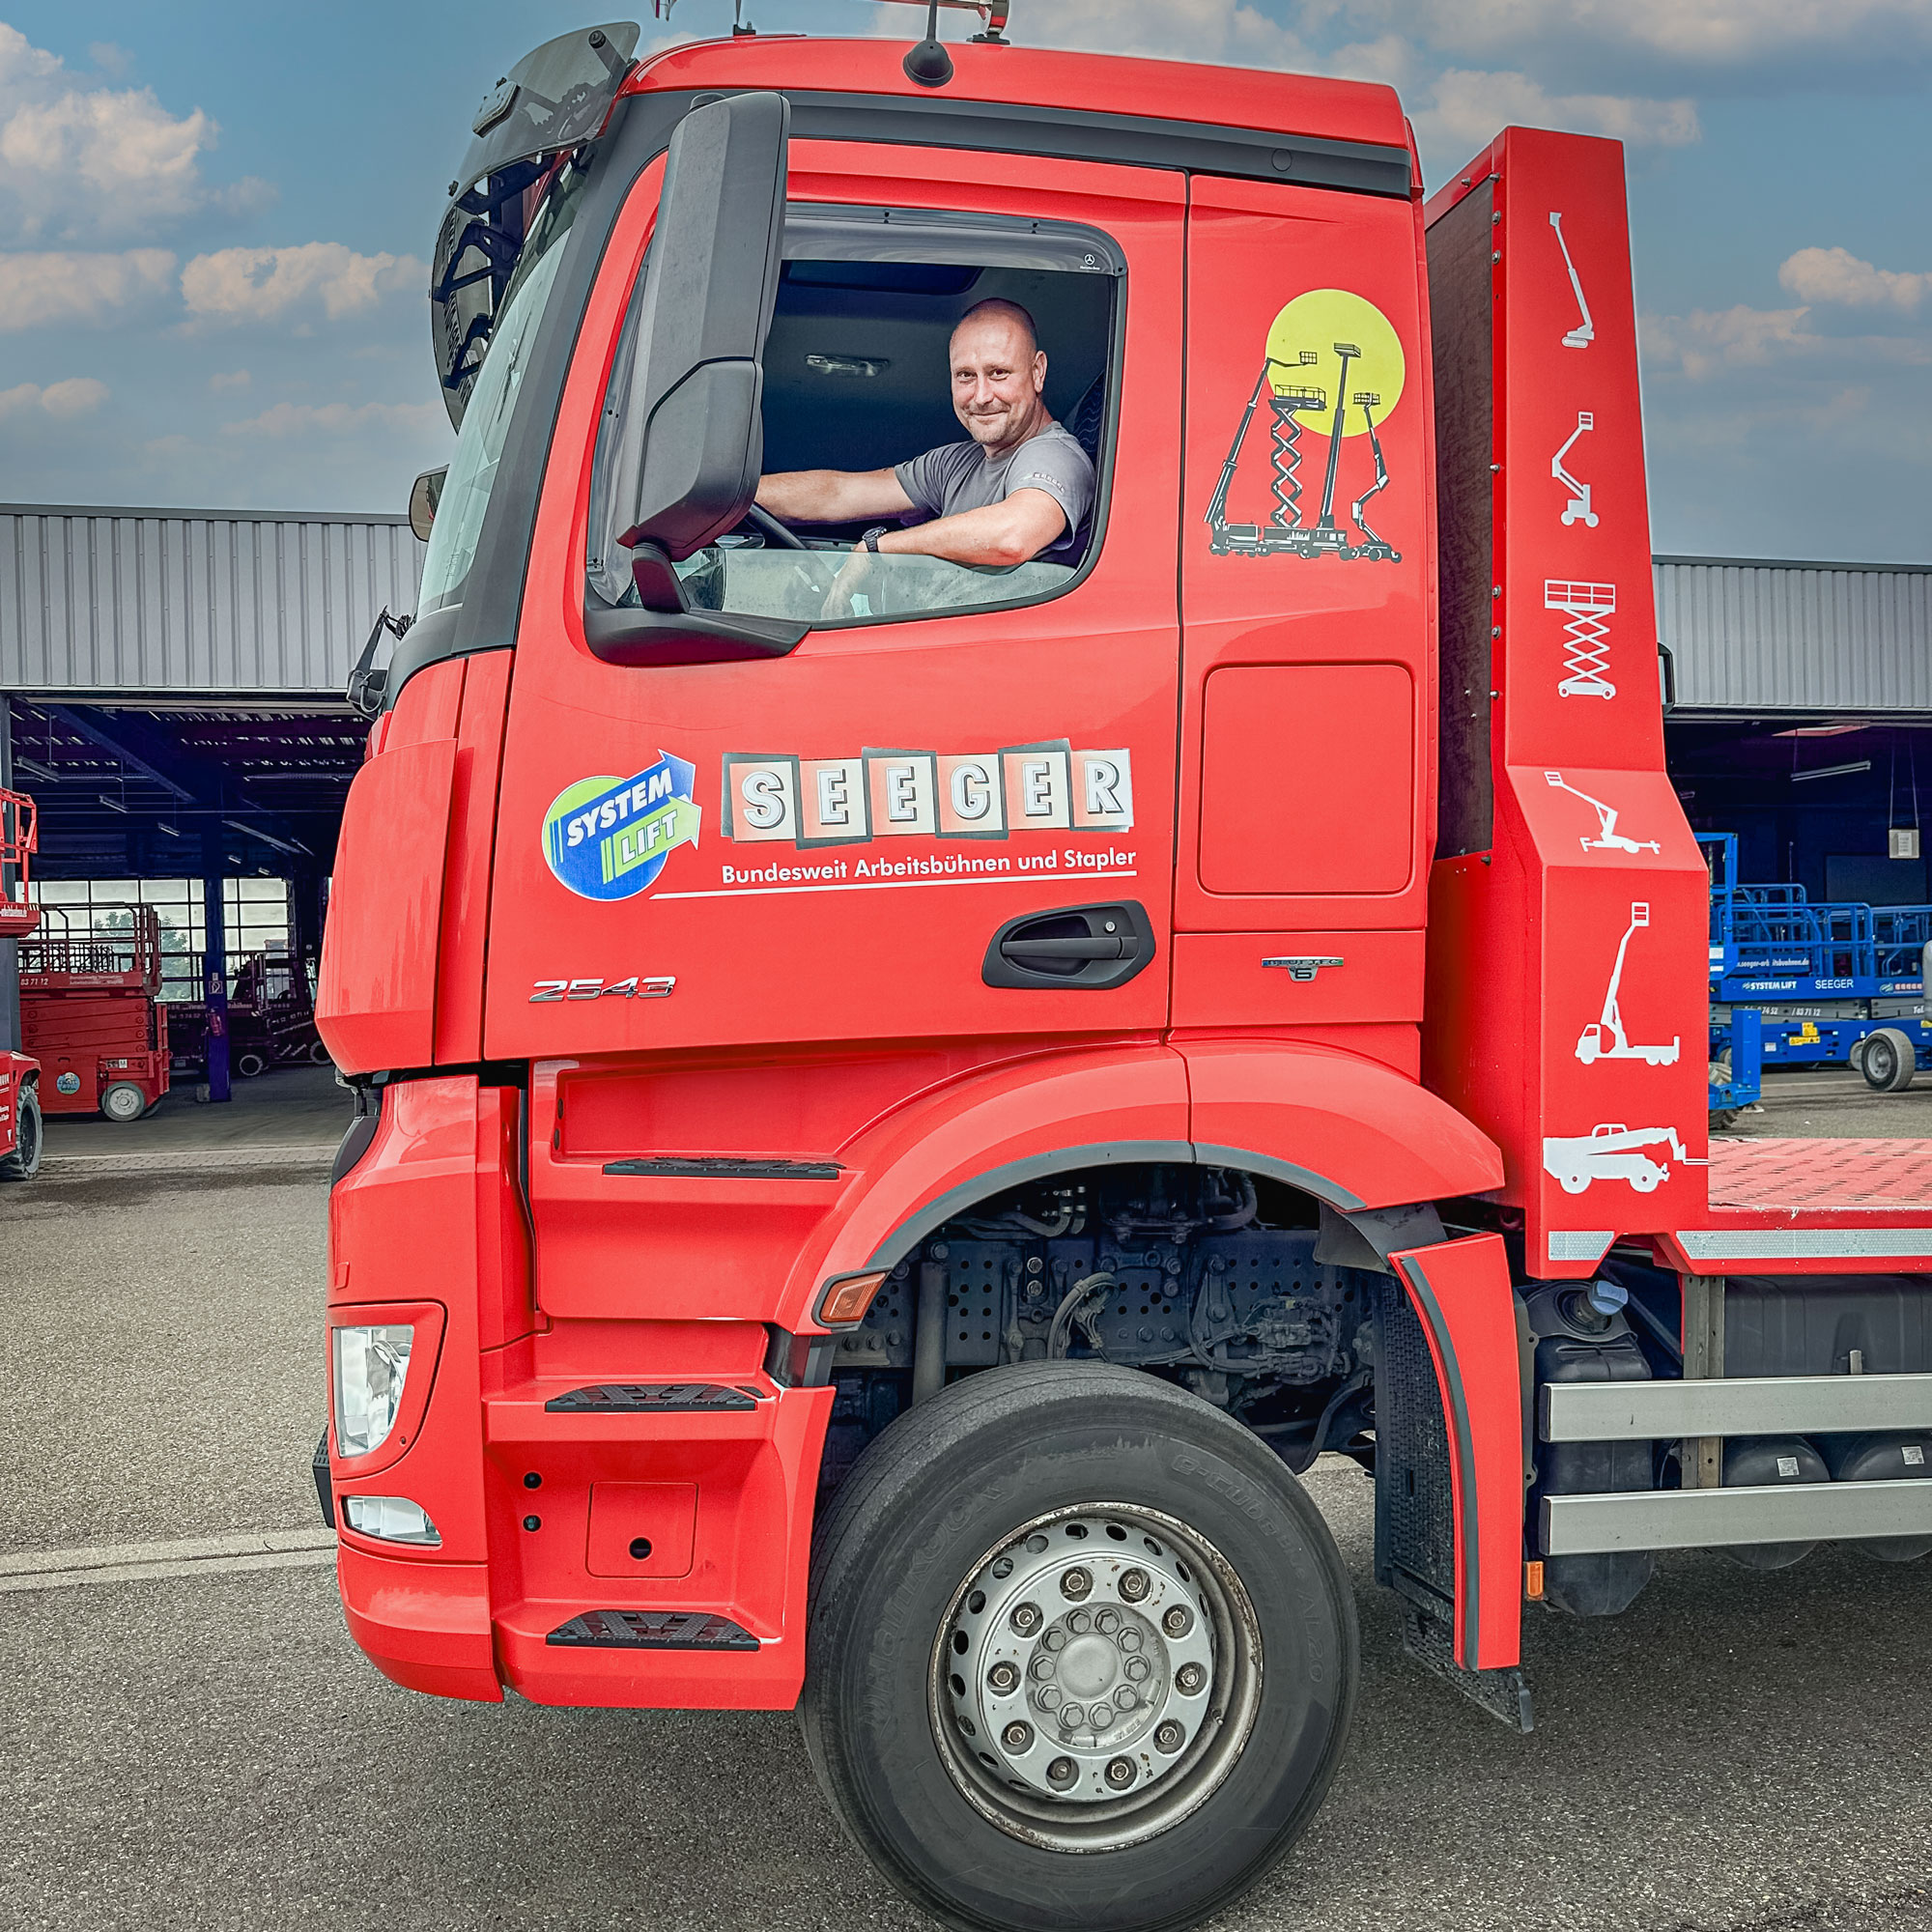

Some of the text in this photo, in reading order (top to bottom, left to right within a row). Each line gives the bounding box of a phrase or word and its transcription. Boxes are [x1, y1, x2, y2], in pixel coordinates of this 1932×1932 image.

[567, 767, 673, 847] SYSTEM
[741, 759, 1125, 830] SEEGER
[621, 809, 678, 866] LIFT
[722, 847, 1137, 884] Bundesweit Arbeitsbühnen und Stapler
[528, 976, 677, 1003] 2543
[1294, 967, 1313, 980] 6
[1750, 980, 1797, 990] SYSTEM LIFT
[1815, 979, 1854, 990] SEEGER
